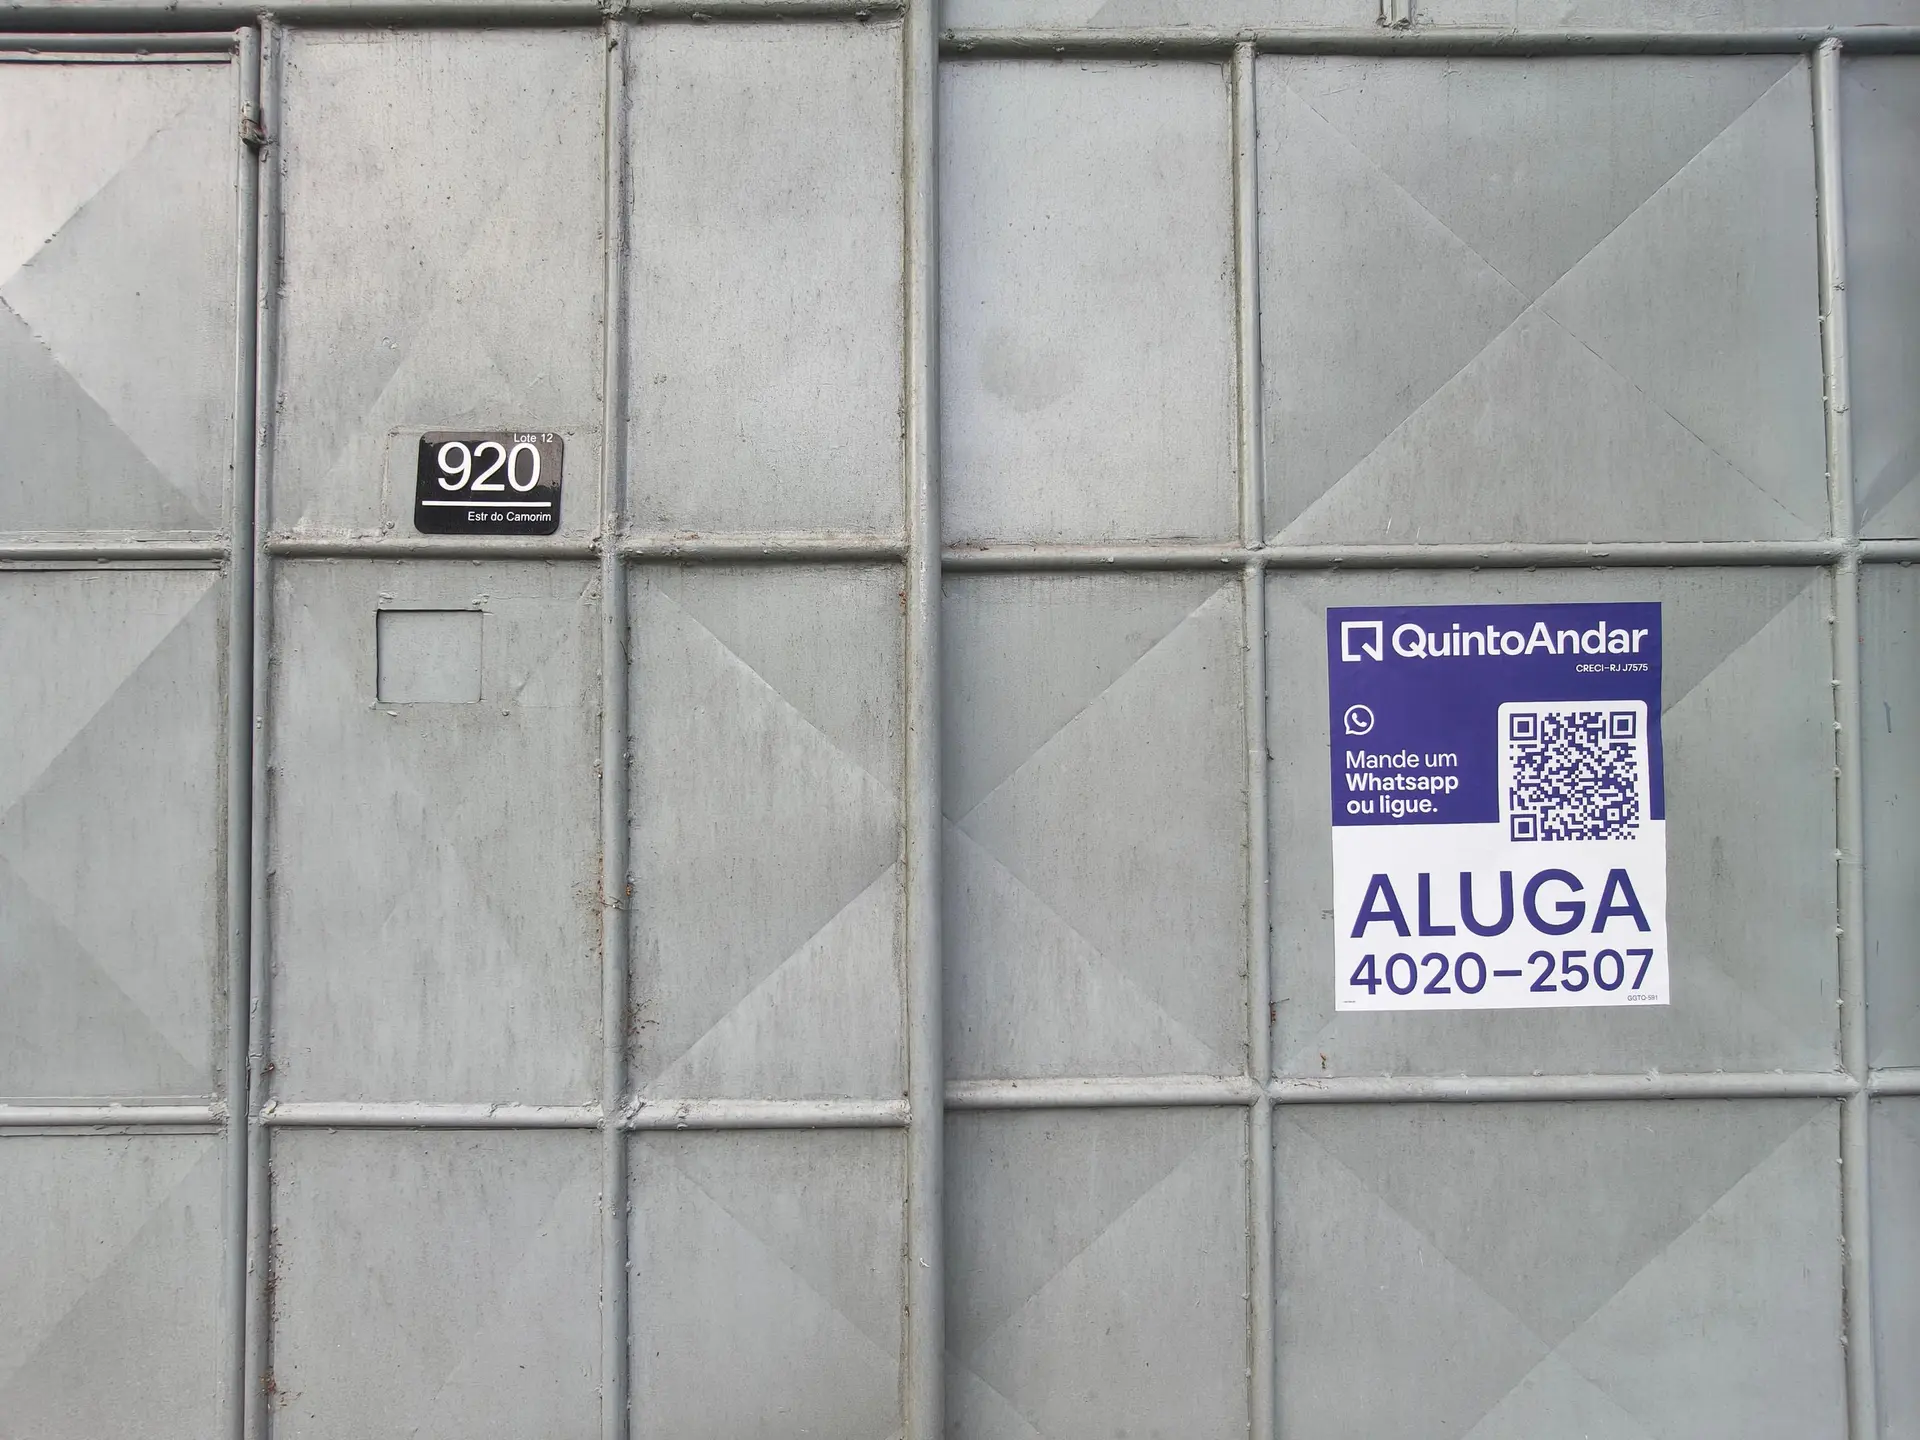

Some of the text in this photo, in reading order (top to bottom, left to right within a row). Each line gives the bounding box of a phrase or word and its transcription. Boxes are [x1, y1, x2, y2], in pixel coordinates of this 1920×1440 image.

[513, 433, 553, 443] Lote 12
[437, 441, 541, 492] 920
[467, 511, 552, 522] Estr do Camorim
[1392, 621, 1649, 660] QuintoAndar
[1575, 663, 1649, 673] CRECI-RJ J7575
[1345, 750, 1458, 769] Mande um
[1345, 773, 1459, 794] Whatsapp
[1346, 795, 1438, 818] ou ligue.
[1350, 868, 1652, 938] ALUGA
[1349, 948, 1654, 995] 4020-2507
